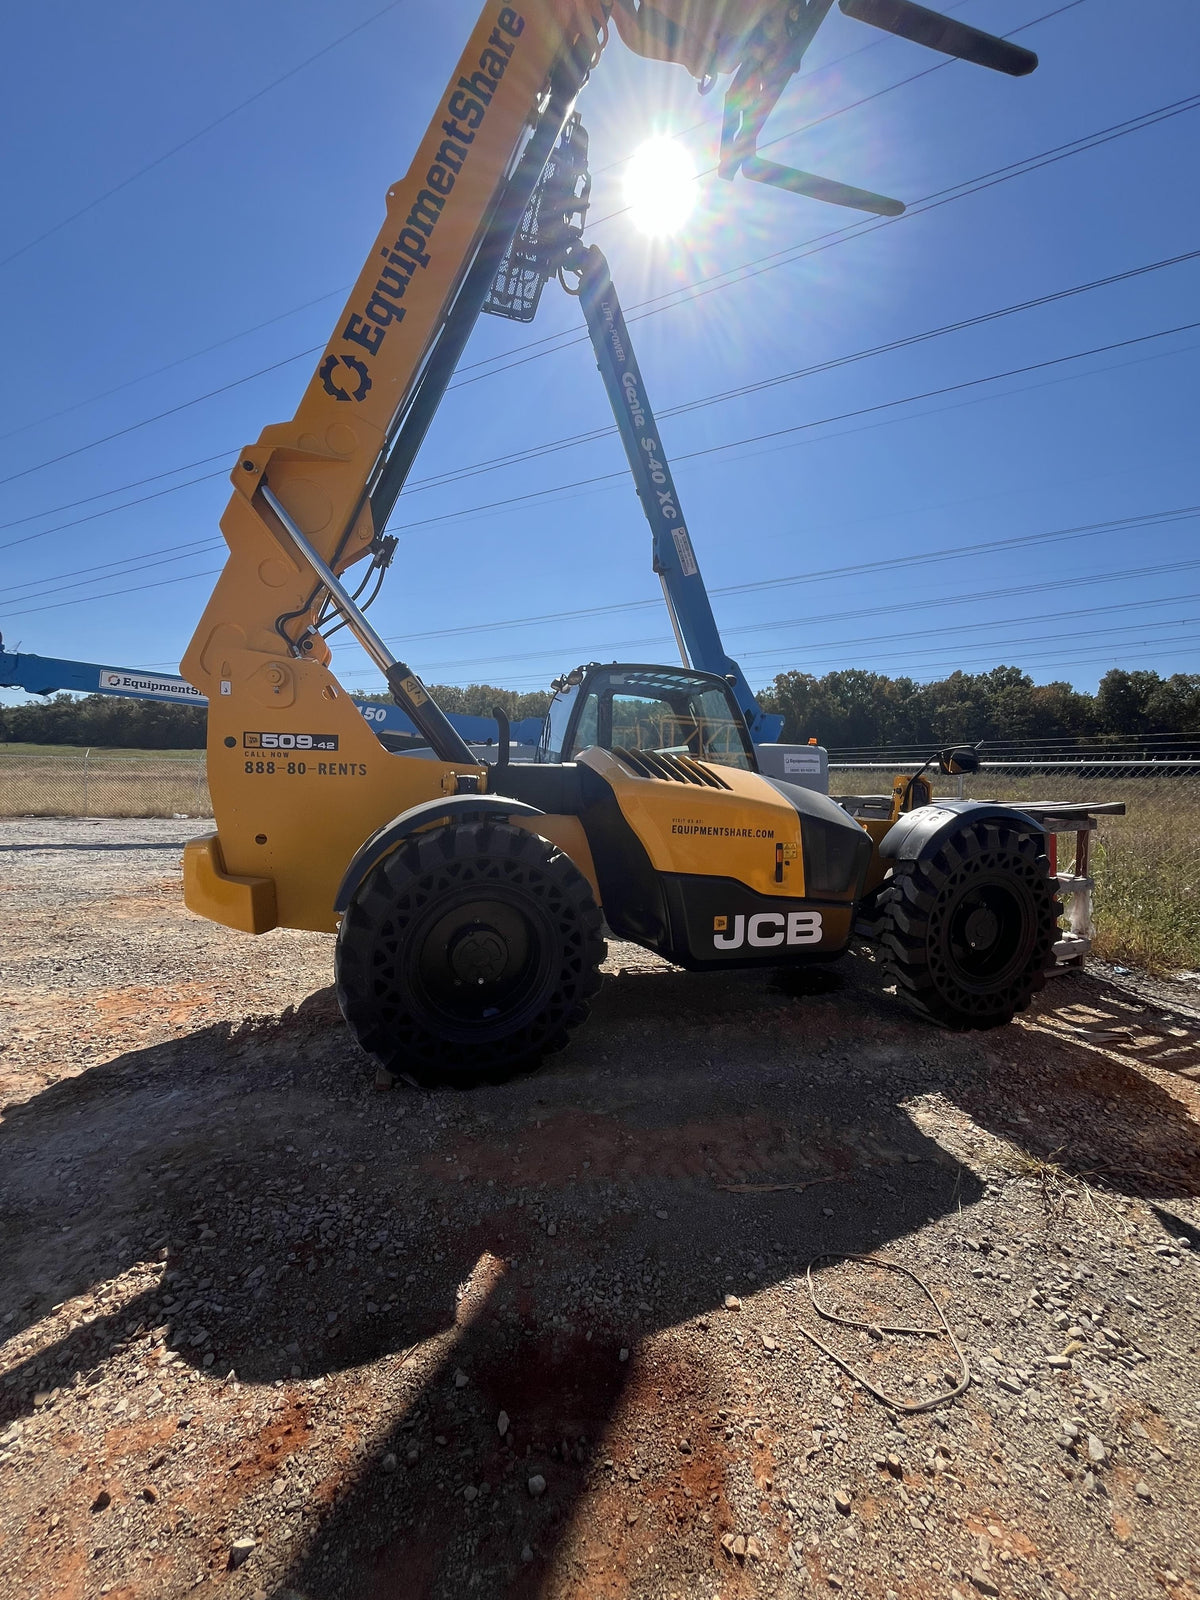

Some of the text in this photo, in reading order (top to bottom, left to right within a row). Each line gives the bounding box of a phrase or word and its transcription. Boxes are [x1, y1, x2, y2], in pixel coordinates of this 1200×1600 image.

[341, 6, 526, 357] EquipmentShare
[609, 329, 626, 361] POWER
[621, 371, 677, 520] Genie S-40 XC
[122, 677, 203, 696] EquipmentS
[270, 751, 290, 759] NOW
[244, 761, 368, 776] 888-80-RENTS
[671, 824, 775, 839] EQUIPMENTSHARE.COM
[713, 911, 823, 950] JCB
